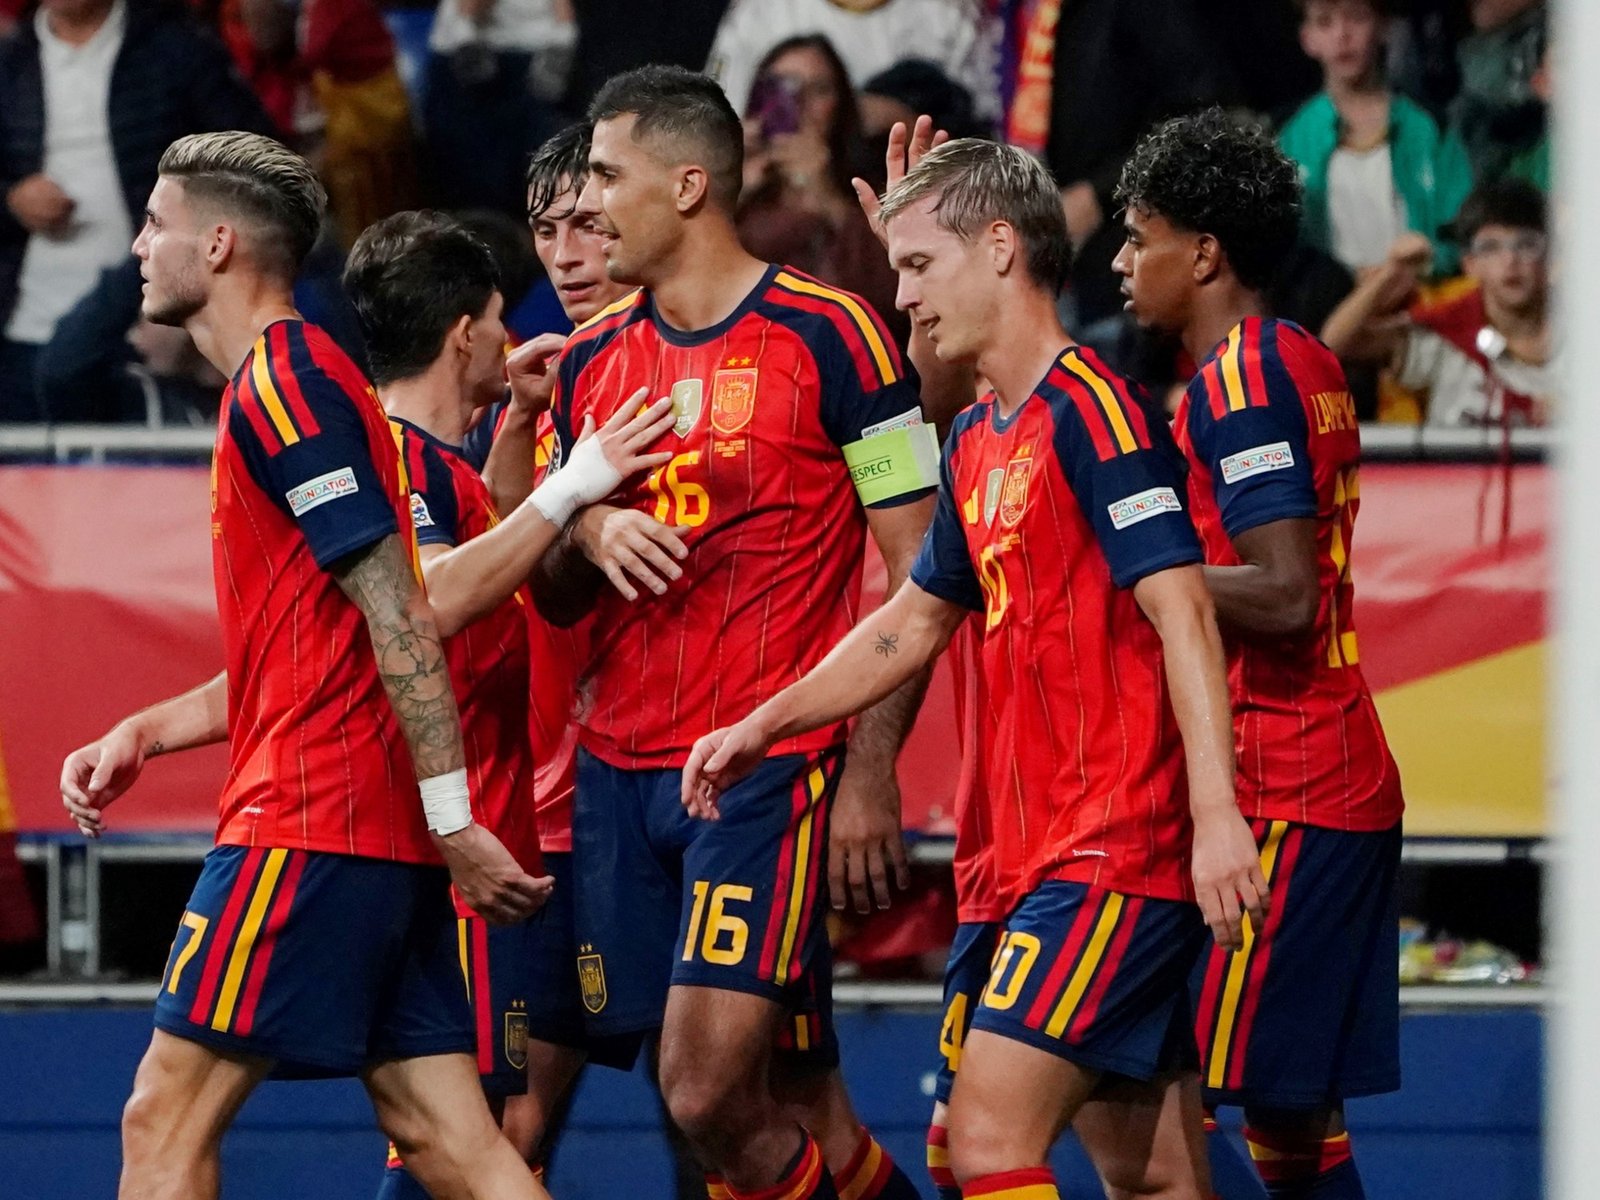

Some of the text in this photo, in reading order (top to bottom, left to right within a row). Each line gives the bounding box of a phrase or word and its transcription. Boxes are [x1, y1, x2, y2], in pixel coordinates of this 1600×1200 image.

[851, 460, 892, 481] ESPECT
[1224, 450, 1290, 475] FOUNDATION
[290, 475, 354, 507] FOUNDATION
[1112, 495, 1178, 520] FOUNDATION
[682, 881, 753, 966] 16
